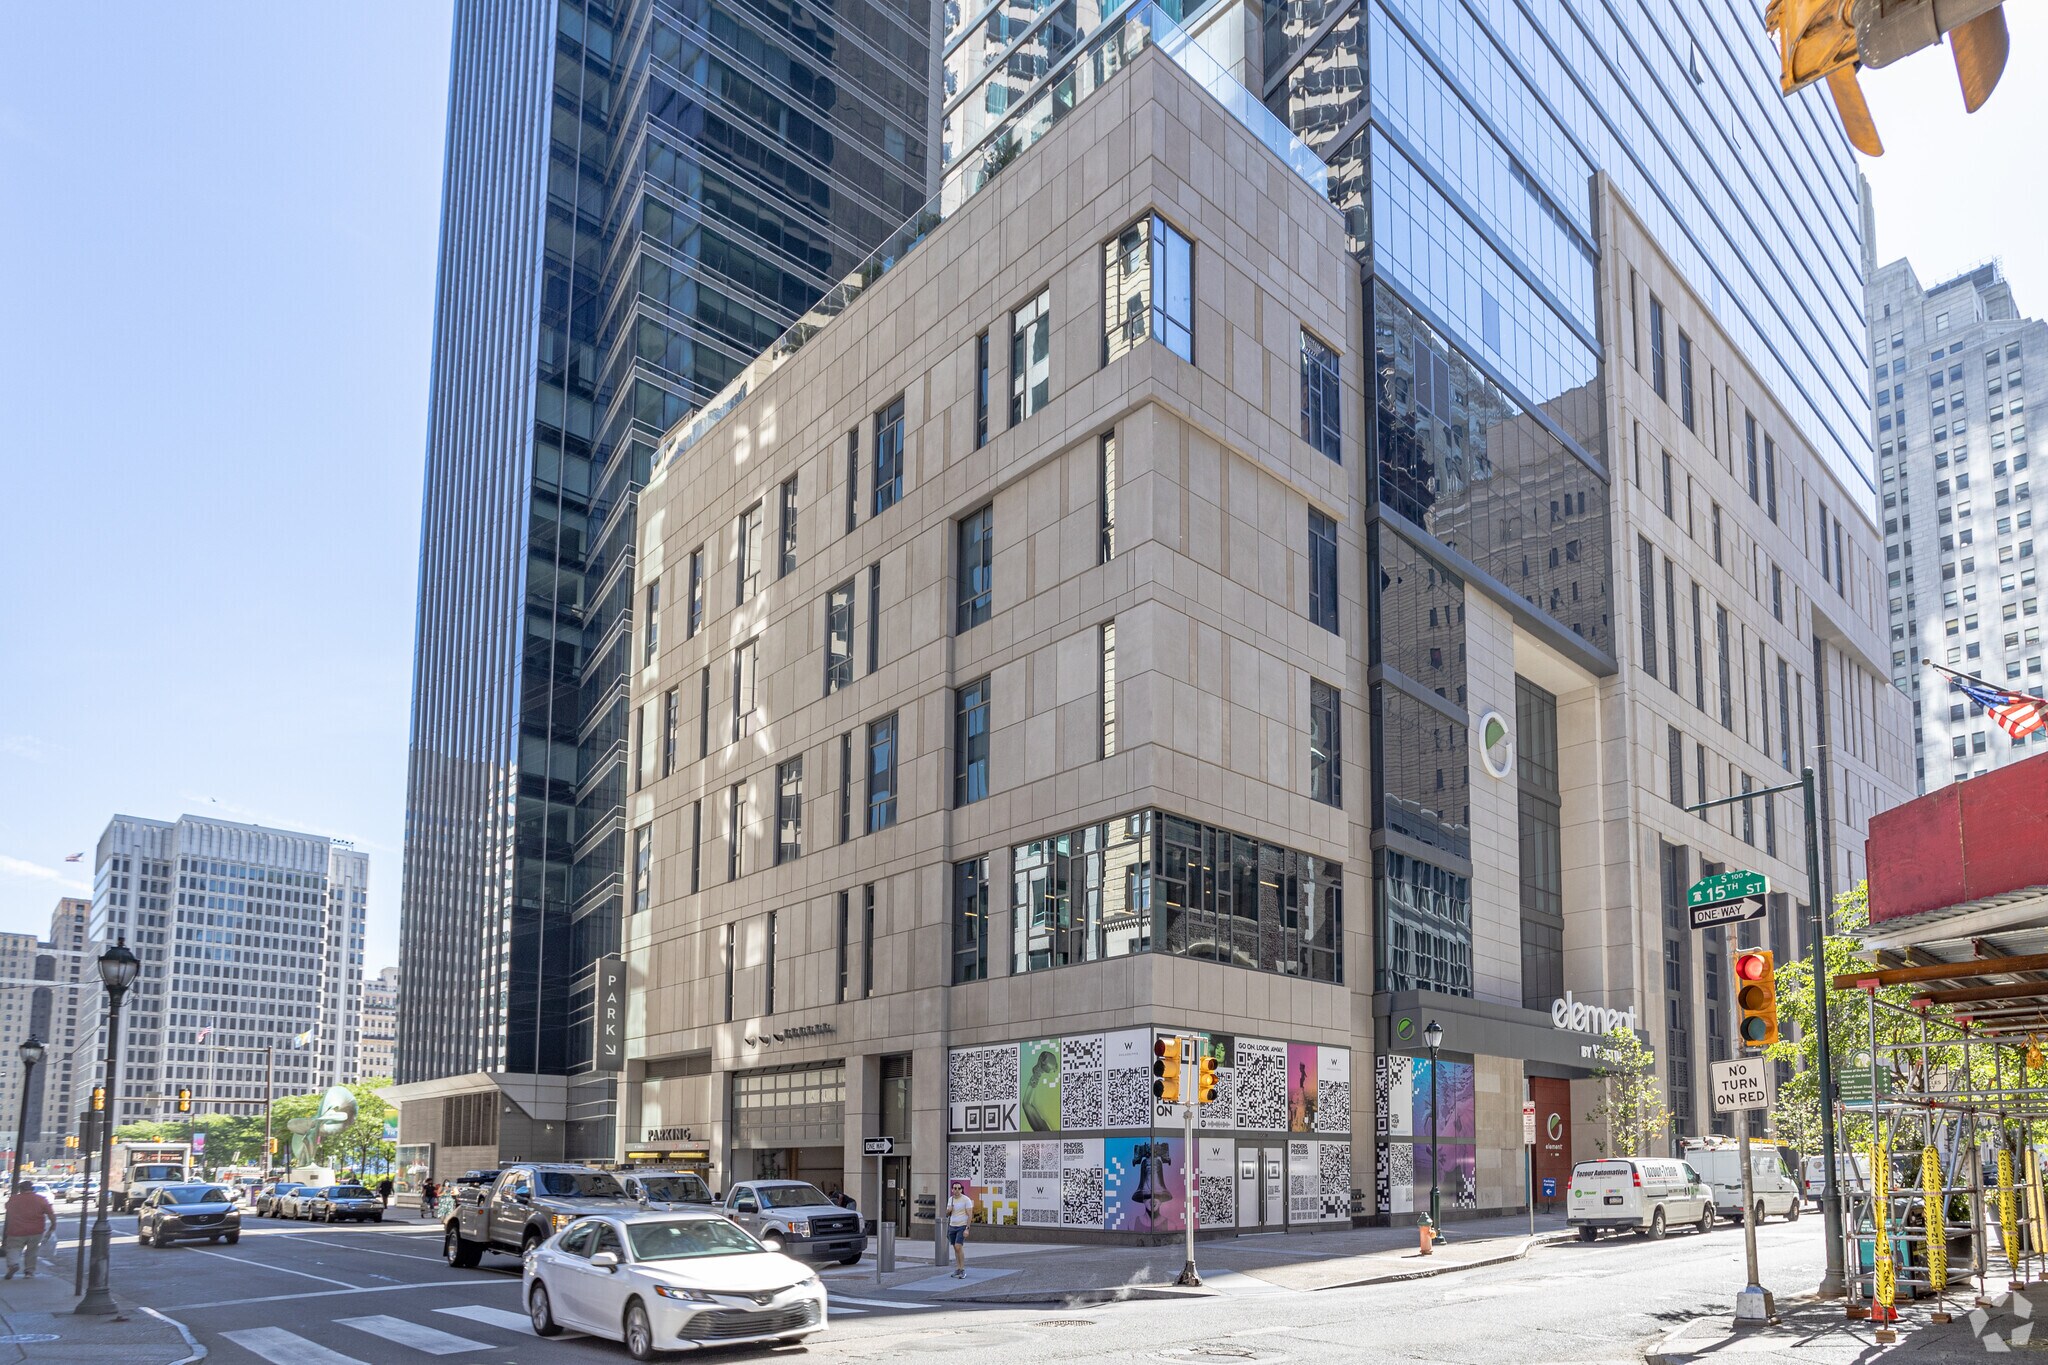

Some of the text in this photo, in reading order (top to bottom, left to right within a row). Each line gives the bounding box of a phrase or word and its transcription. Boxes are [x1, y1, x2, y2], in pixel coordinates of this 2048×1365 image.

[1720, 875, 1727, 883] S
[1706, 882, 1762, 902] 15TH ST
[1697, 905, 1742, 922] ONE WAY
[605, 974, 617, 1036] PARK
[1552, 990, 1637, 1039] element
[1124, 1042, 1133, 1050] W
[1257, 1044, 1270, 1052] LOOK
[1580, 1045, 1592, 1058] BY
[1729, 1065, 1747, 1076] NO
[1721, 1077, 1757, 1091] TURN
[1717, 1091, 1765, 1105] ON RED
[1156, 1105, 1173, 1117] ON
[648, 1128, 691, 1142] PARKING
[1211, 1148, 1220, 1156] W
[1594, 1169, 1628, 1177] Automation
[1924, 1148, 1935, 1191] WARNING
[1036, 1186, 1044, 1194] W
[1999, 1152, 2009, 1187] WARNING
[2004, 1191, 2012, 1231] TRIPPING
[1929, 1196, 1940, 1244] TRIPPING
[1933, 1251, 1943, 1288] HAZARD
